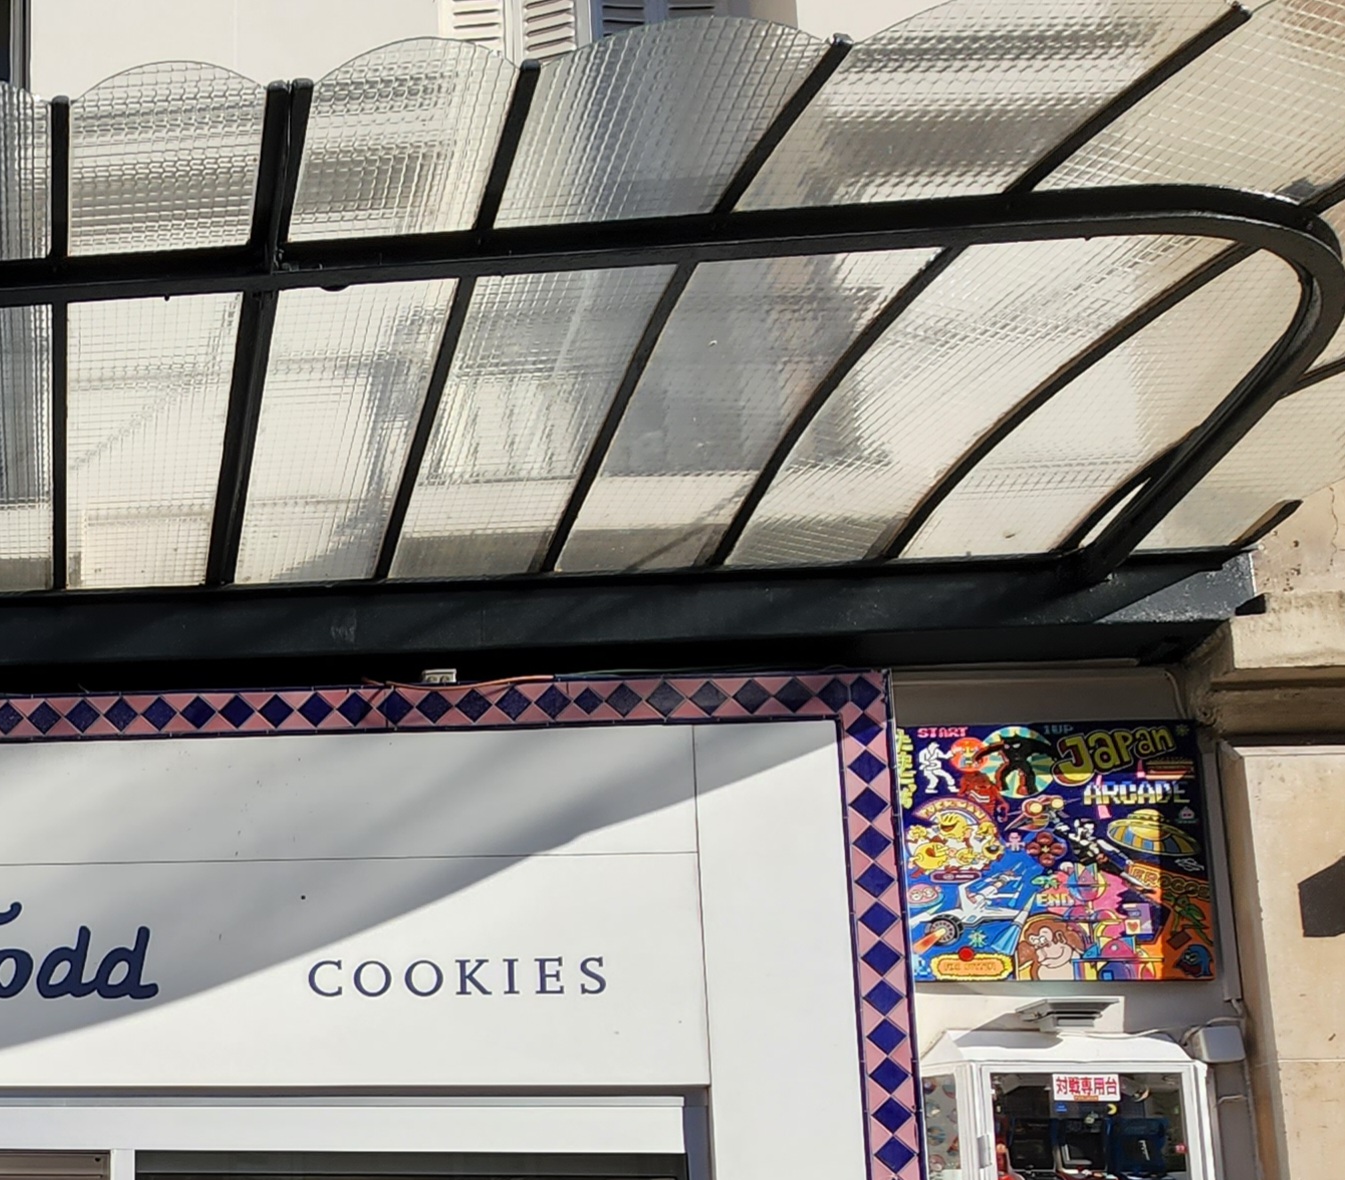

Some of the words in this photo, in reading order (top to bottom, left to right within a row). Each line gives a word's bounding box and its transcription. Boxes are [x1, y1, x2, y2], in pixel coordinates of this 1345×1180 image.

[917, 726, 968, 738] START
[1043, 724, 1074, 735] 1UP
[1053, 726, 1176, 786] Japan
[1082, 780, 1191, 806] ARCADE
[1035, 893, 1075, 907] END
[308, 956, 607, 997] COOKIES
[1056, 1076, 1118, 1095] 対戦専用台
